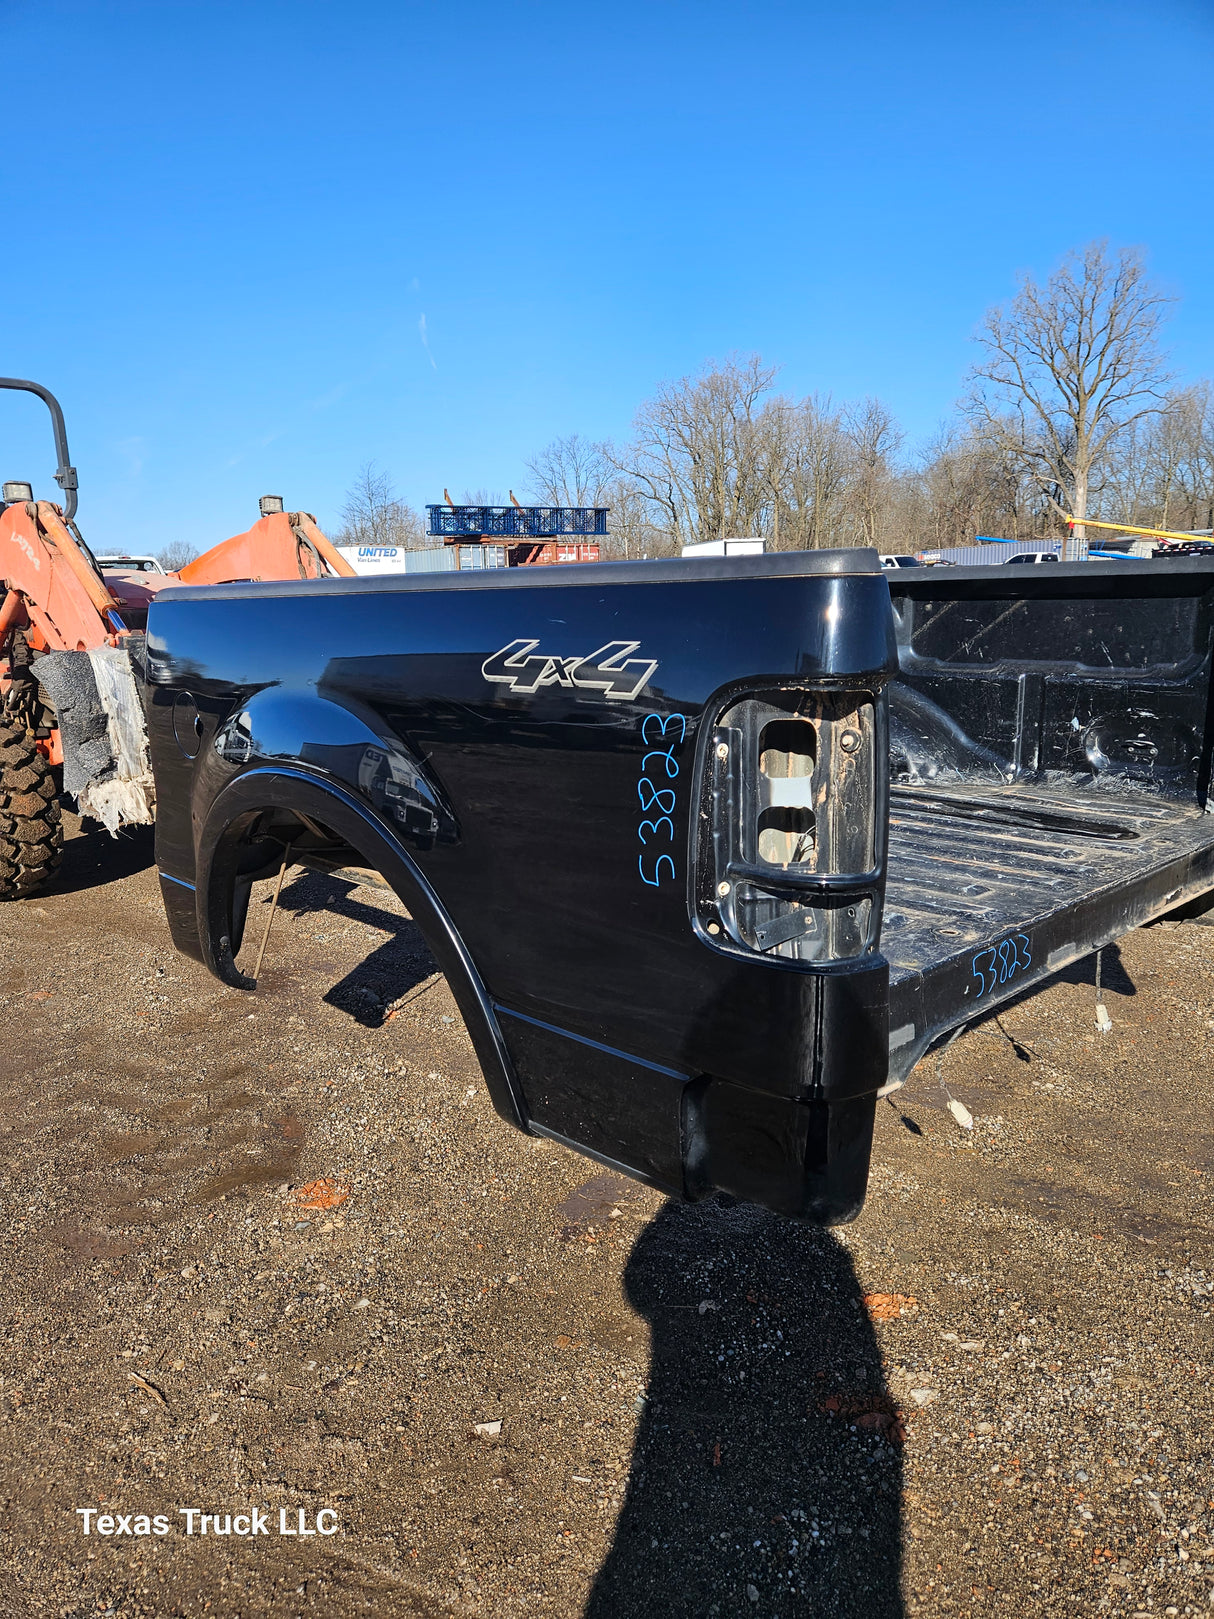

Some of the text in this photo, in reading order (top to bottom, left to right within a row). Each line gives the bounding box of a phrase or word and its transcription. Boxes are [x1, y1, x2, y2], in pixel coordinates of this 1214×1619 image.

[358, 547, 397, 557] UNITED
[482, 638, 659, 701] 4x4
[637, 713, 686, 888] 53823
[972, 934, 1032, 998] 53823
